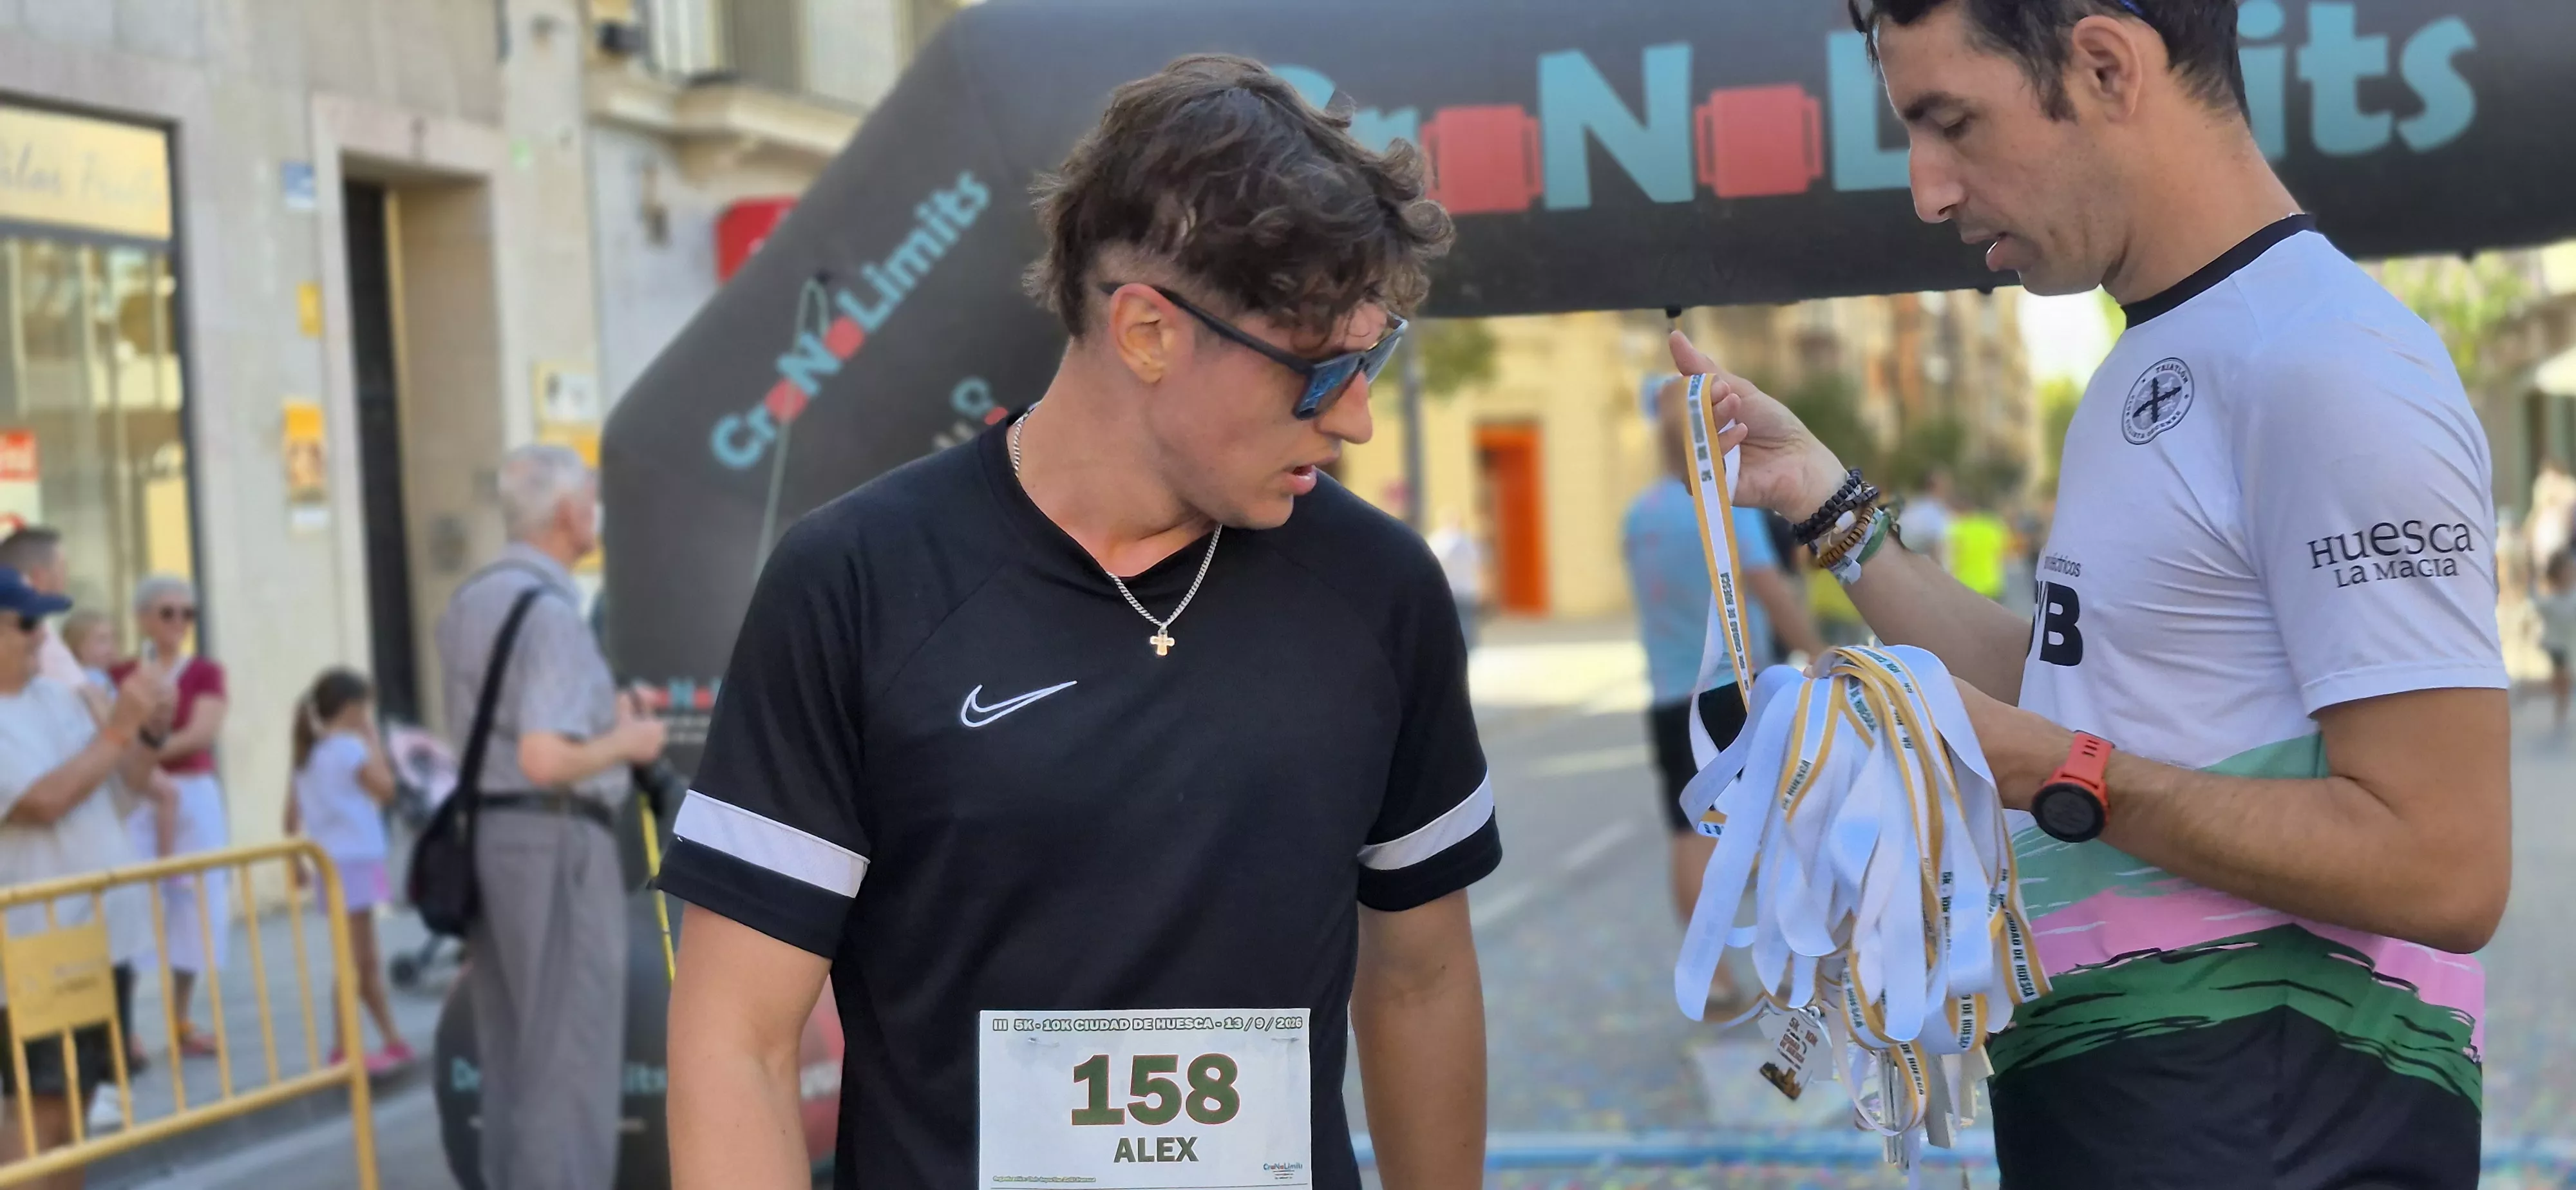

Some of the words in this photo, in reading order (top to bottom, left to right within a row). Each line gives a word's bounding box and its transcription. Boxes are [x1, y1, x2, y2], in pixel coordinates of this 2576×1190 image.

[1720, 572, 1734, 605] HUESCA
[1727, 607, 1737, 618] DE
[2013, 949, 2025, 961] DE
[993, 1019, 1009, 1031] III
[1014, 1019, 1034, 1031] 5K
[1042, 1018, 1072, 1031] 10K
[1074, 1018, 1131, 1031] CIUDAD
[1132, 1018, 1153, 1030] DE
[1155, 1017, 1214, 1030] HUESCA
[1072, 1054, 1240, 1126] 158
[1113, 1137, 1200, 1163] ALEX
